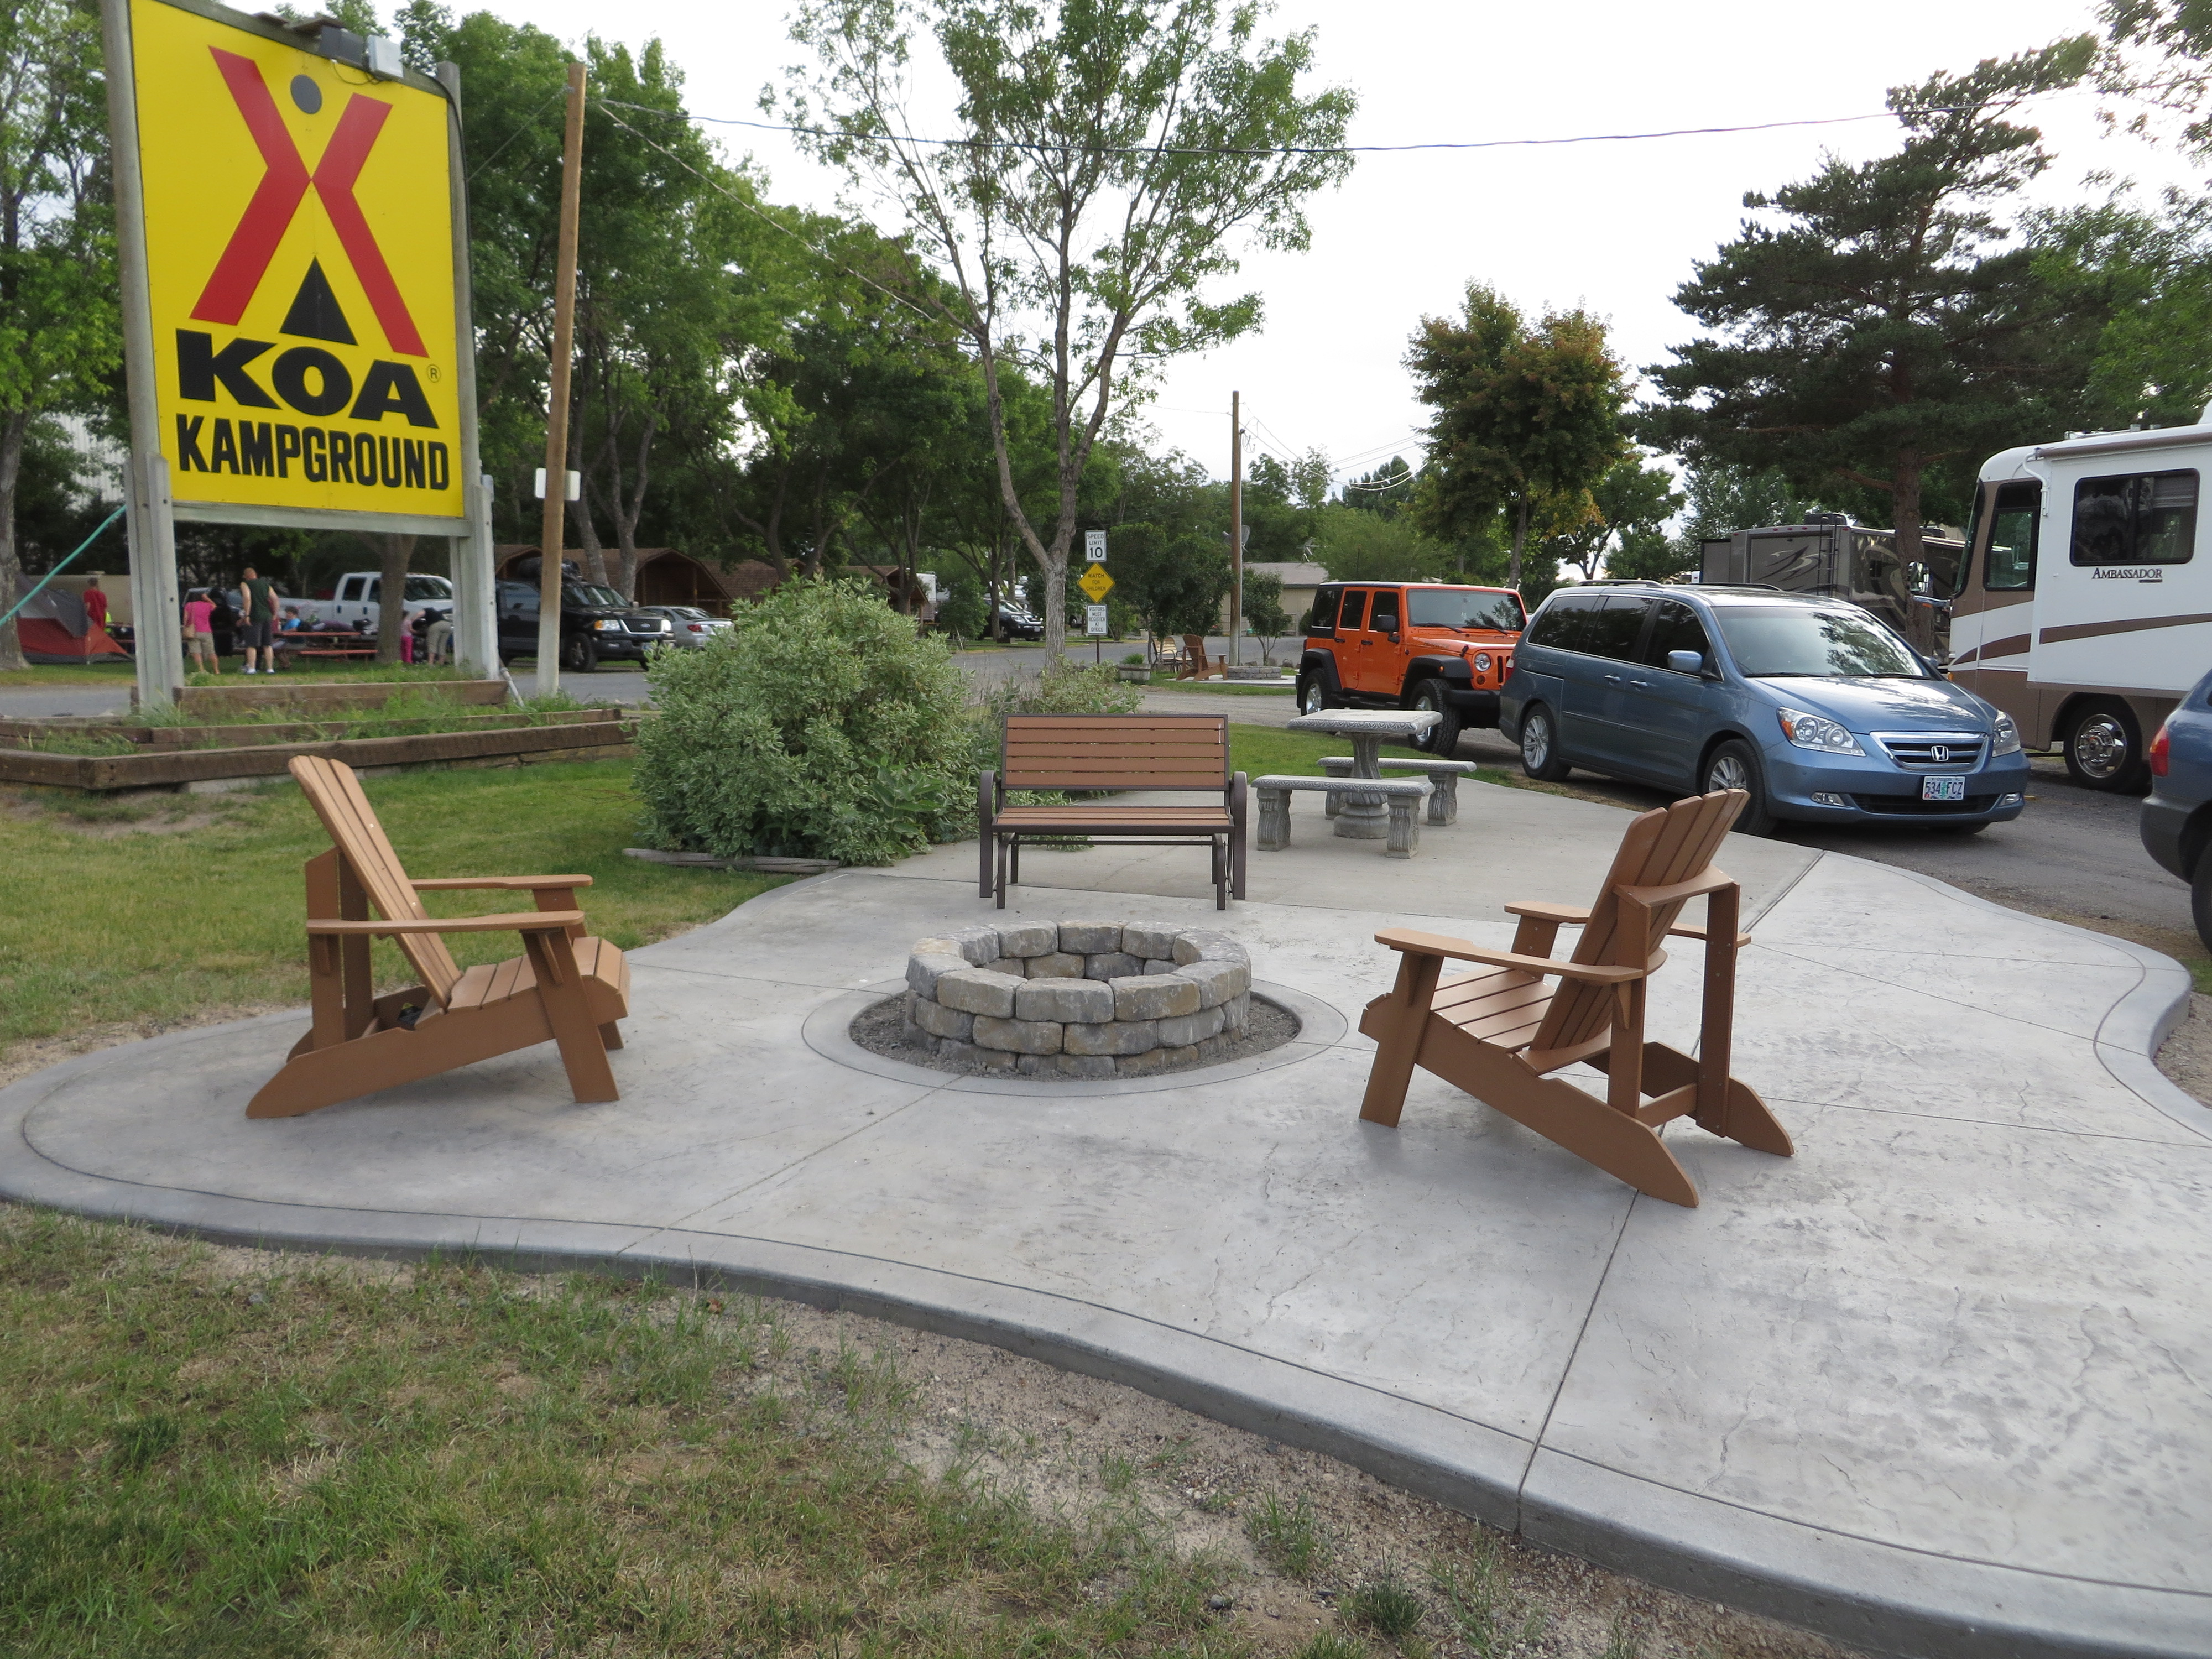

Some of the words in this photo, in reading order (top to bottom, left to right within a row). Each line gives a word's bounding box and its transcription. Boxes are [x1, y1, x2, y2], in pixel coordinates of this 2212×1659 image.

[175, 328, 440, 429] KOA
[176, 413, 450, 491] KAMPGROUND
[1089, 547, 1103, 558] 10
[2091, 567, 2163, 580] AMBASSADOR
[1926, 782, 1941, 794] 534
[1947, 782, 1963, 795] FCZ
